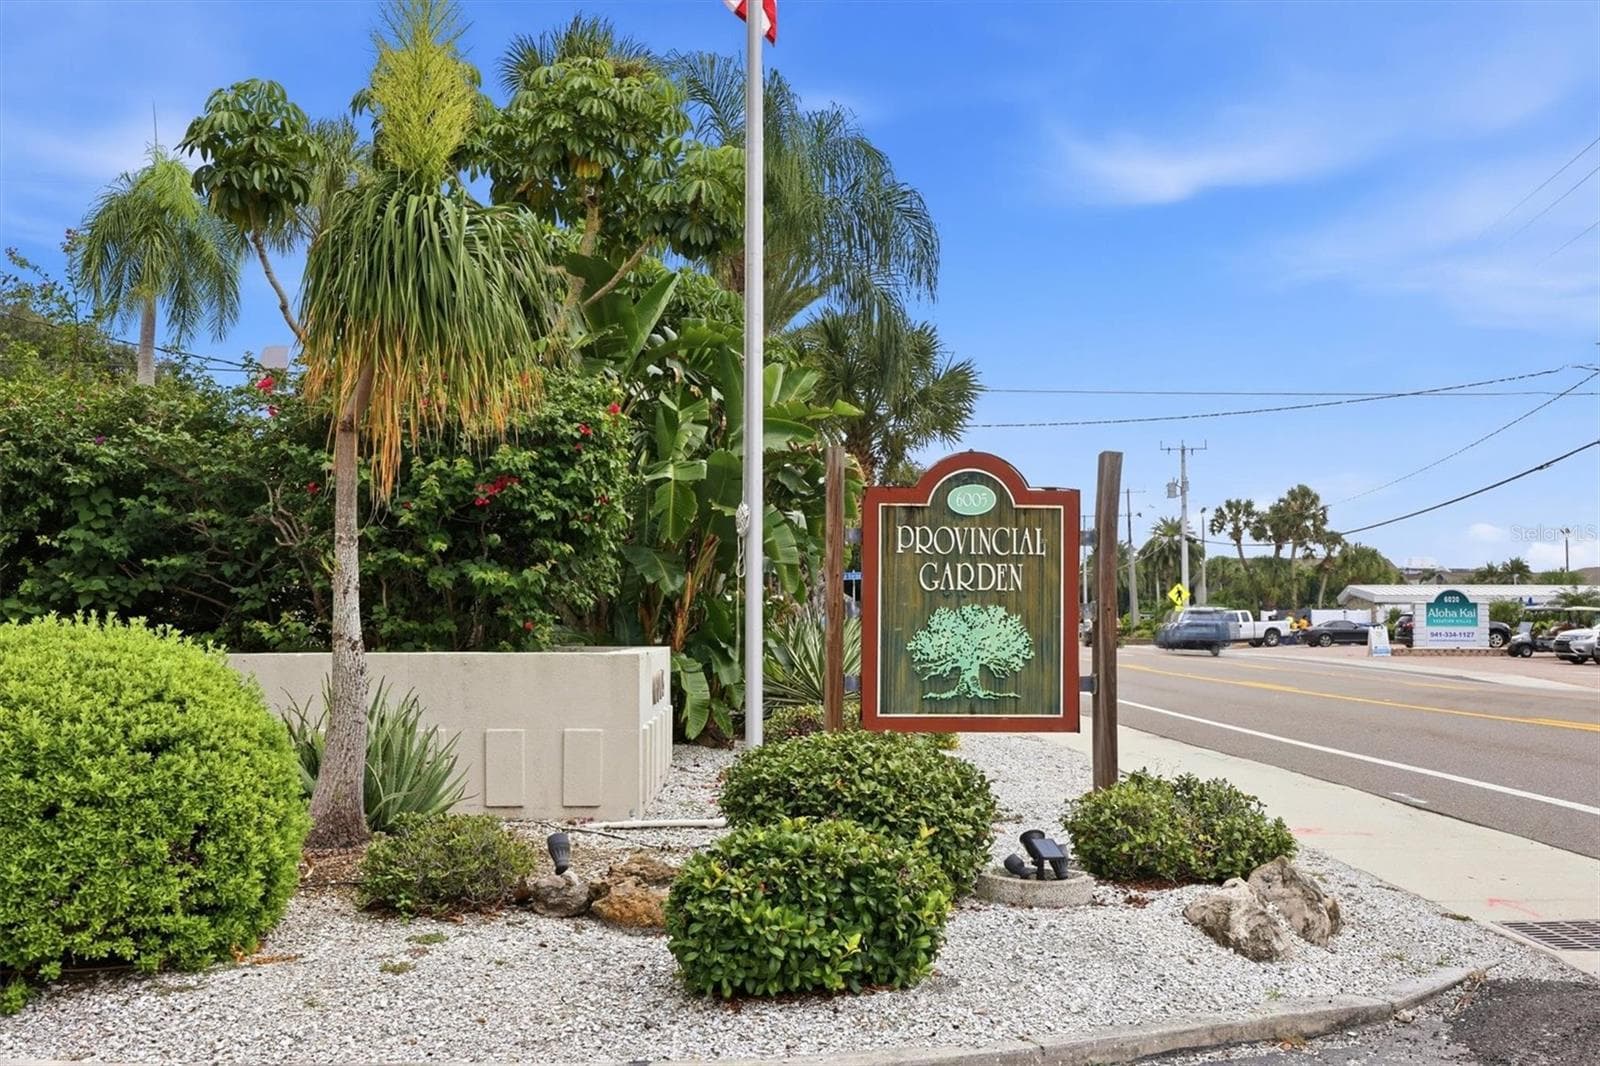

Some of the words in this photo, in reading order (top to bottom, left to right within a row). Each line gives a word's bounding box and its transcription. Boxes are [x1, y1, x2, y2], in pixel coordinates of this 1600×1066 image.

[955, 492, 988, 507] 6005
[896, 525, 1047, 557] PROVINCIAL
[919, 562, 1024, 592] GARDEN
[1428, 608, 1458, 618] Aloha
[1460, 608, 1476, 618] Kai
